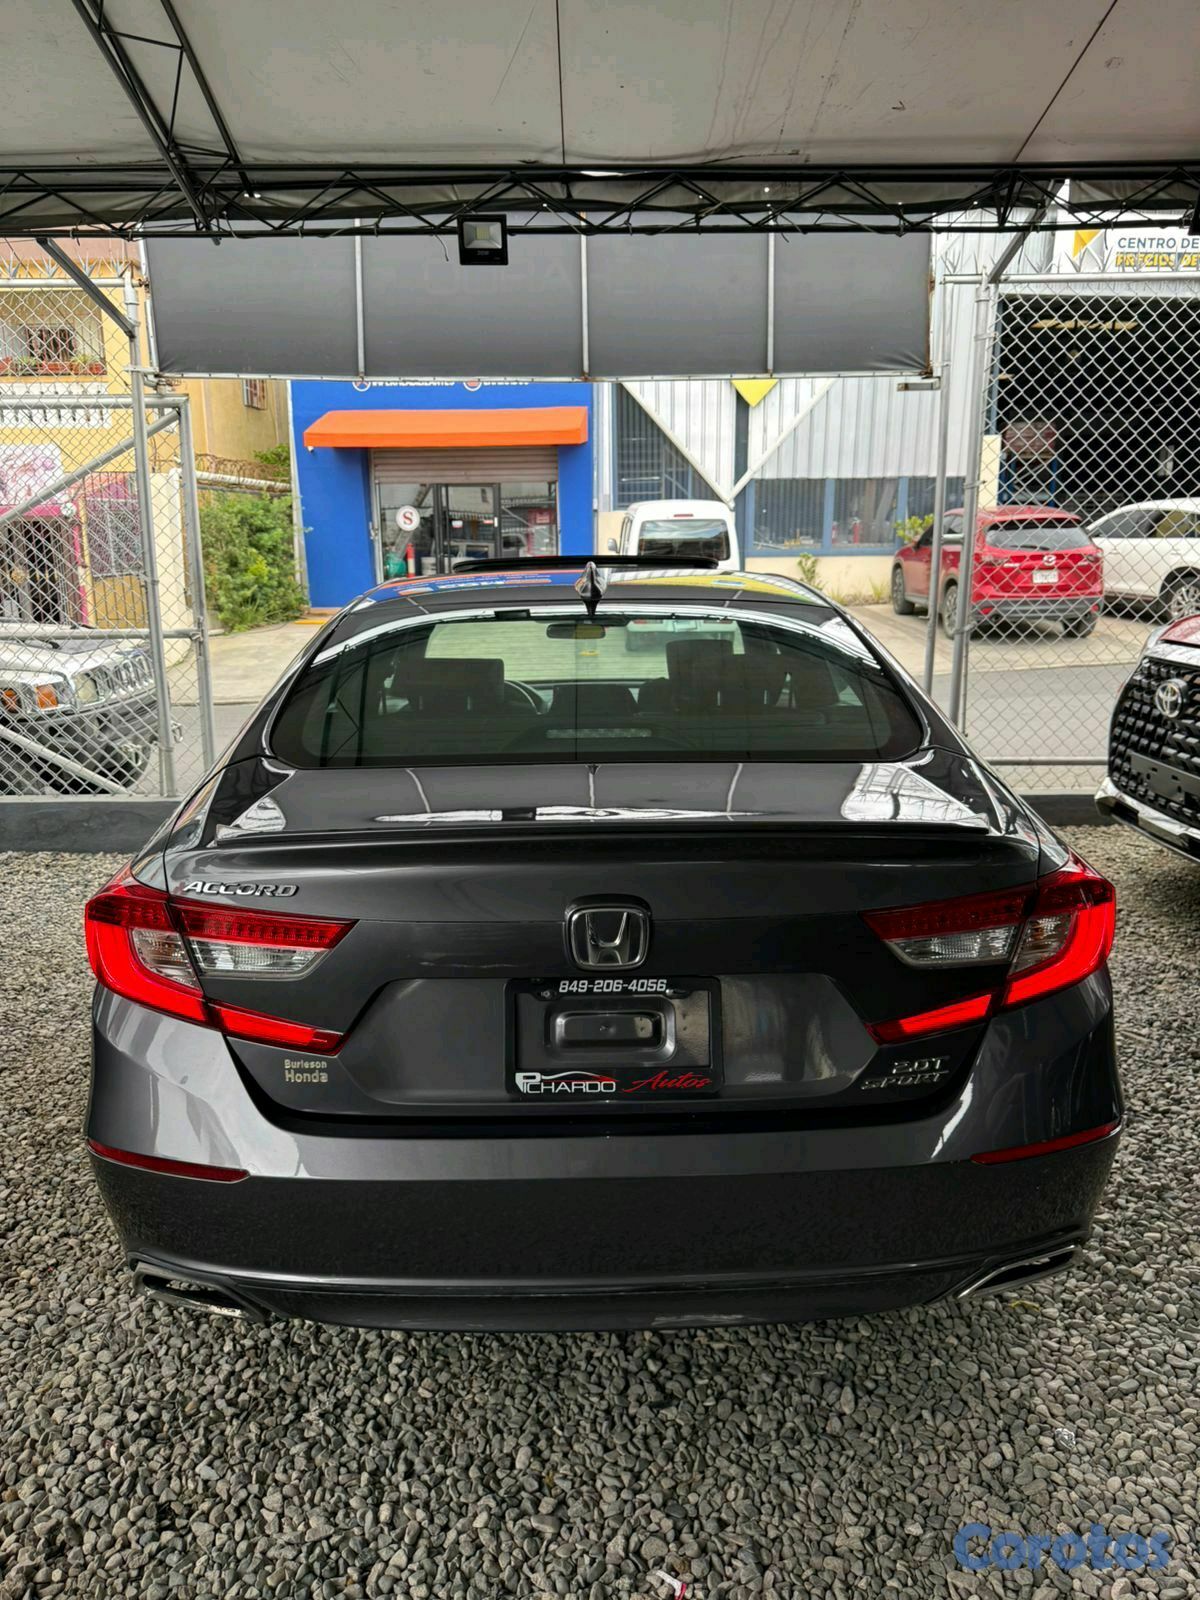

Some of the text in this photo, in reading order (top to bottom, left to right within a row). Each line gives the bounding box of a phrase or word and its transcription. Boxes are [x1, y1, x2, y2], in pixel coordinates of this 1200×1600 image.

[1117, 237, 1199, 249] CENTRO DE
[403, 510, 414, 526] S
[183, 881, 299, 898] ACCORD
[558, 979, 668, 993] 849-206-4056
[284, 1059, 328, 1069] Burleson
[284, 1069, 329, 1083] Honda
[515, 1071, 713, 1094] PICHARDO Autos
[860, 1070, 950, 1090] SPORT
